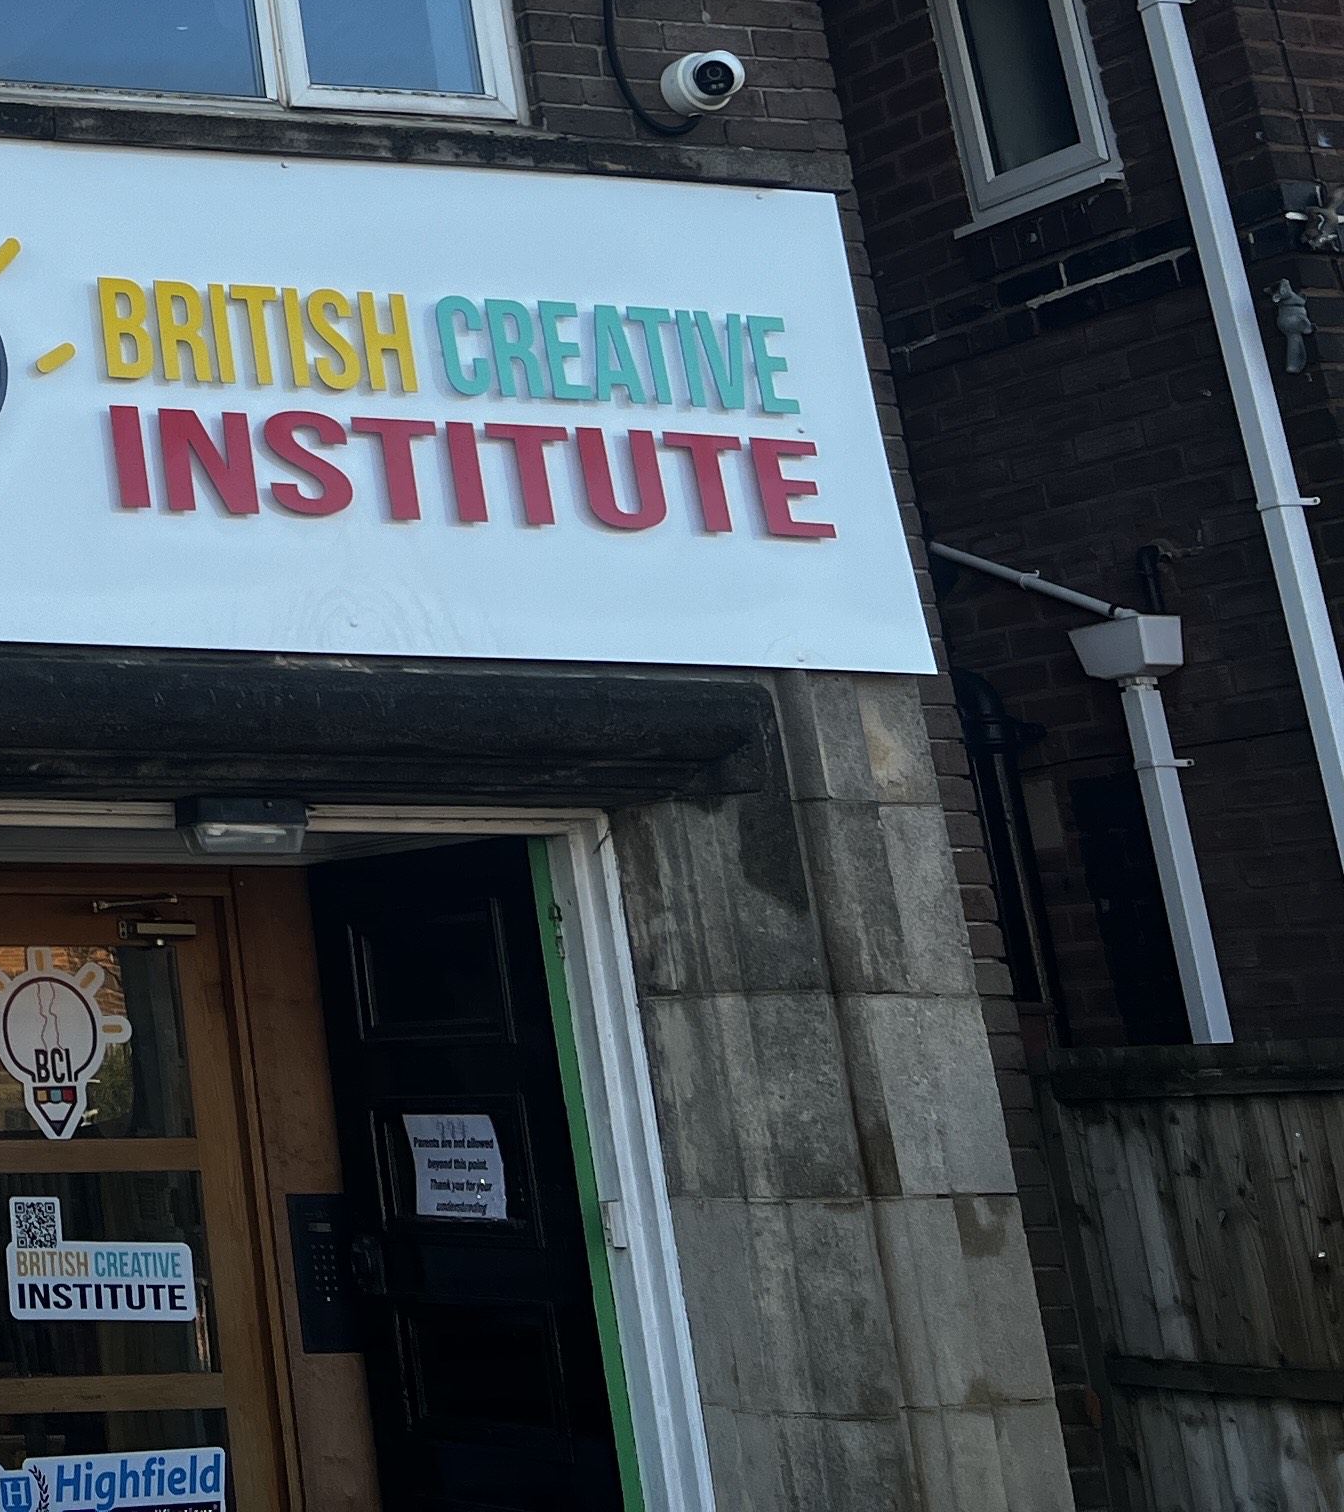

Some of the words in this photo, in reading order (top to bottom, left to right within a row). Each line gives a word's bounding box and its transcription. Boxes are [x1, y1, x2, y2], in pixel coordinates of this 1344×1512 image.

[97, 276, 419, 394] BRITISH
[435, 295, 801, 415] CREATIVE
[109, 404, 837, 539] INSTITUTE
[34, 1048, 73, 1083] BCI
[16, 1250, 89, 1277] BRITISH
[94, 1251, 182, 1278] CREATIVE
[17, 1283, 188, 1311] INSTITUTE
[55, 1454, 221, 1512] Highfield
